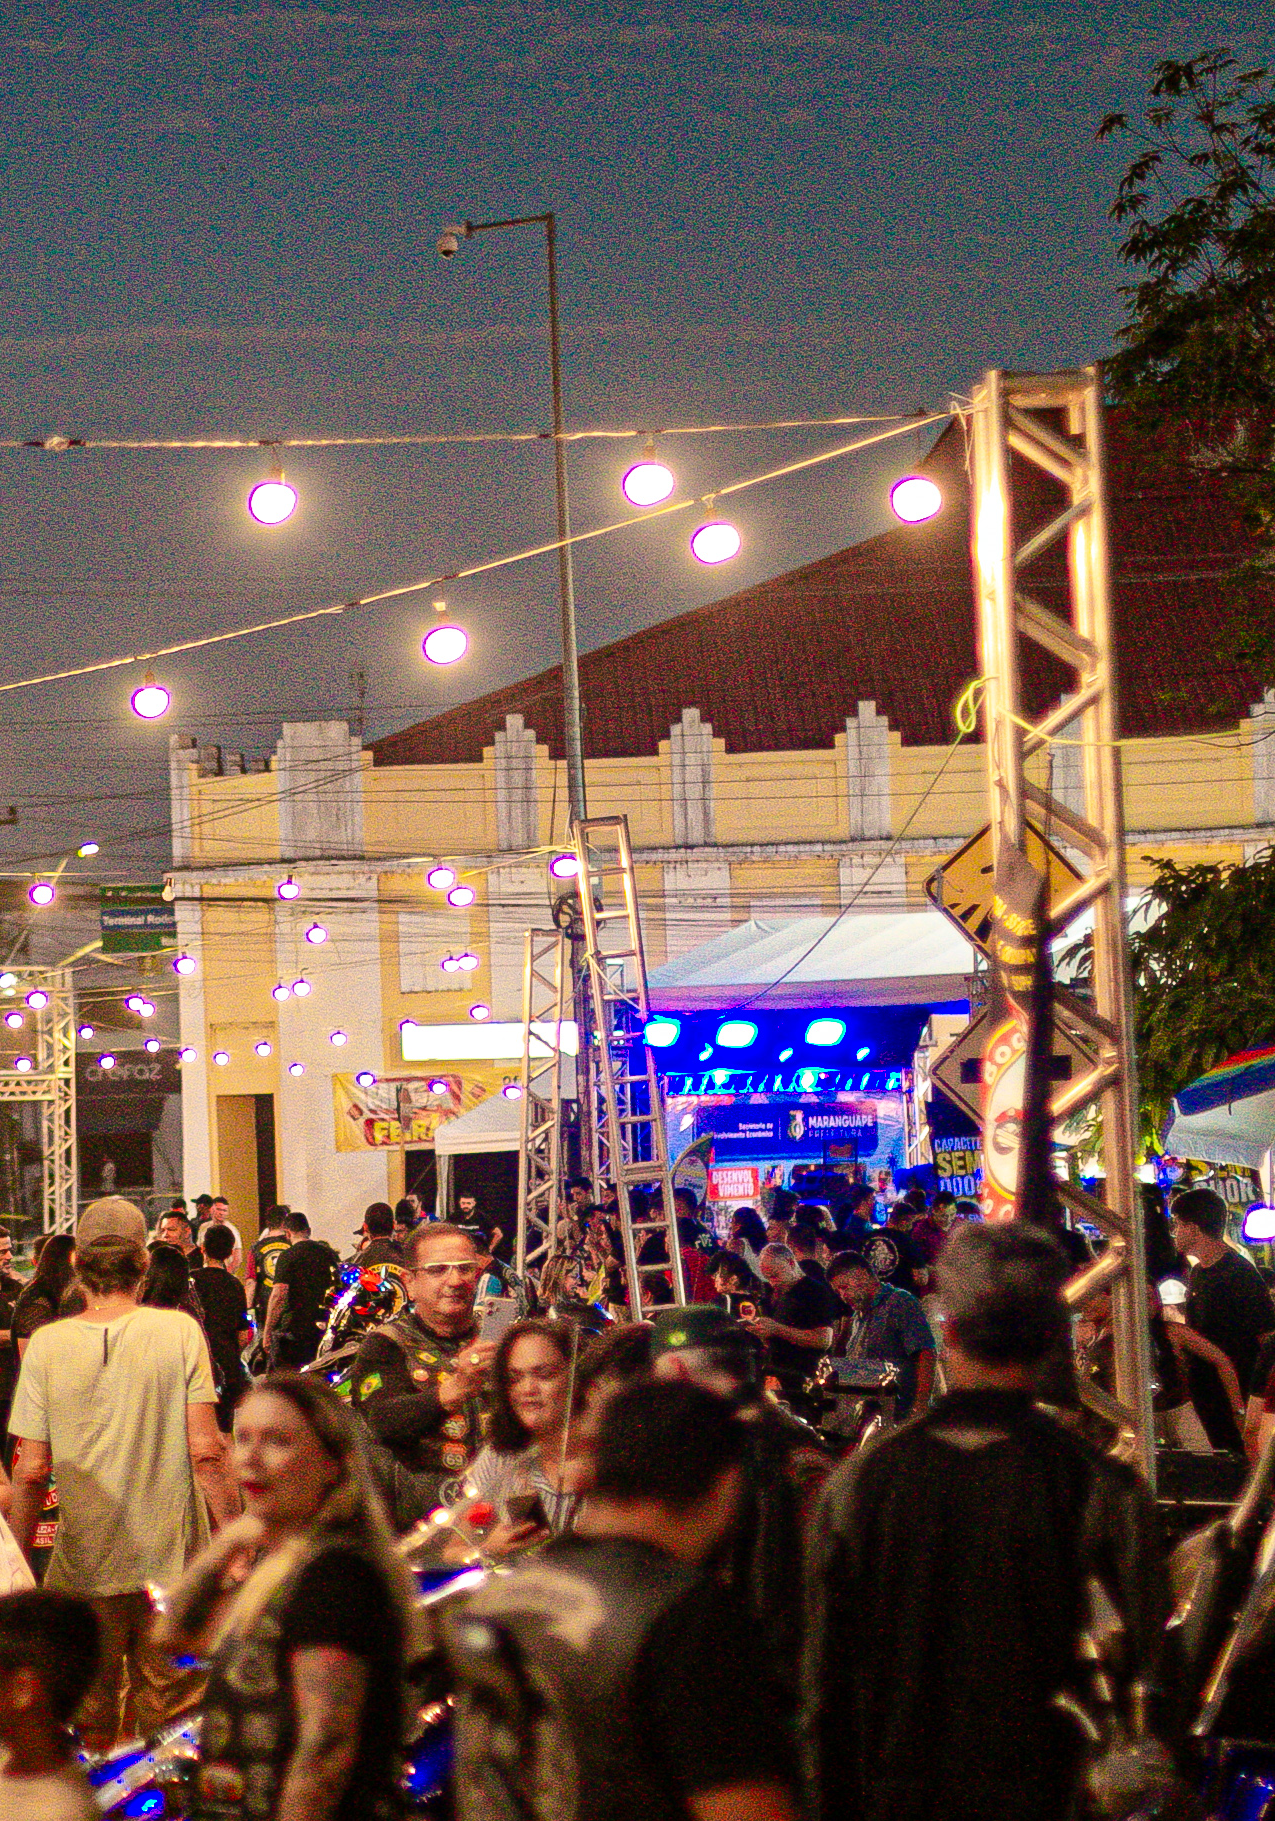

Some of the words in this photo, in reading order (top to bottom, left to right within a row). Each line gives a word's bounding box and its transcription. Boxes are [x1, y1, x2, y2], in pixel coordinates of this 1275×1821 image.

[808, 1114, 874, 1129] MARANGUAPE
[712, 1170, 753, 1184] DESENVOL
[718, 1182, 755, 1197] VIMENTO
